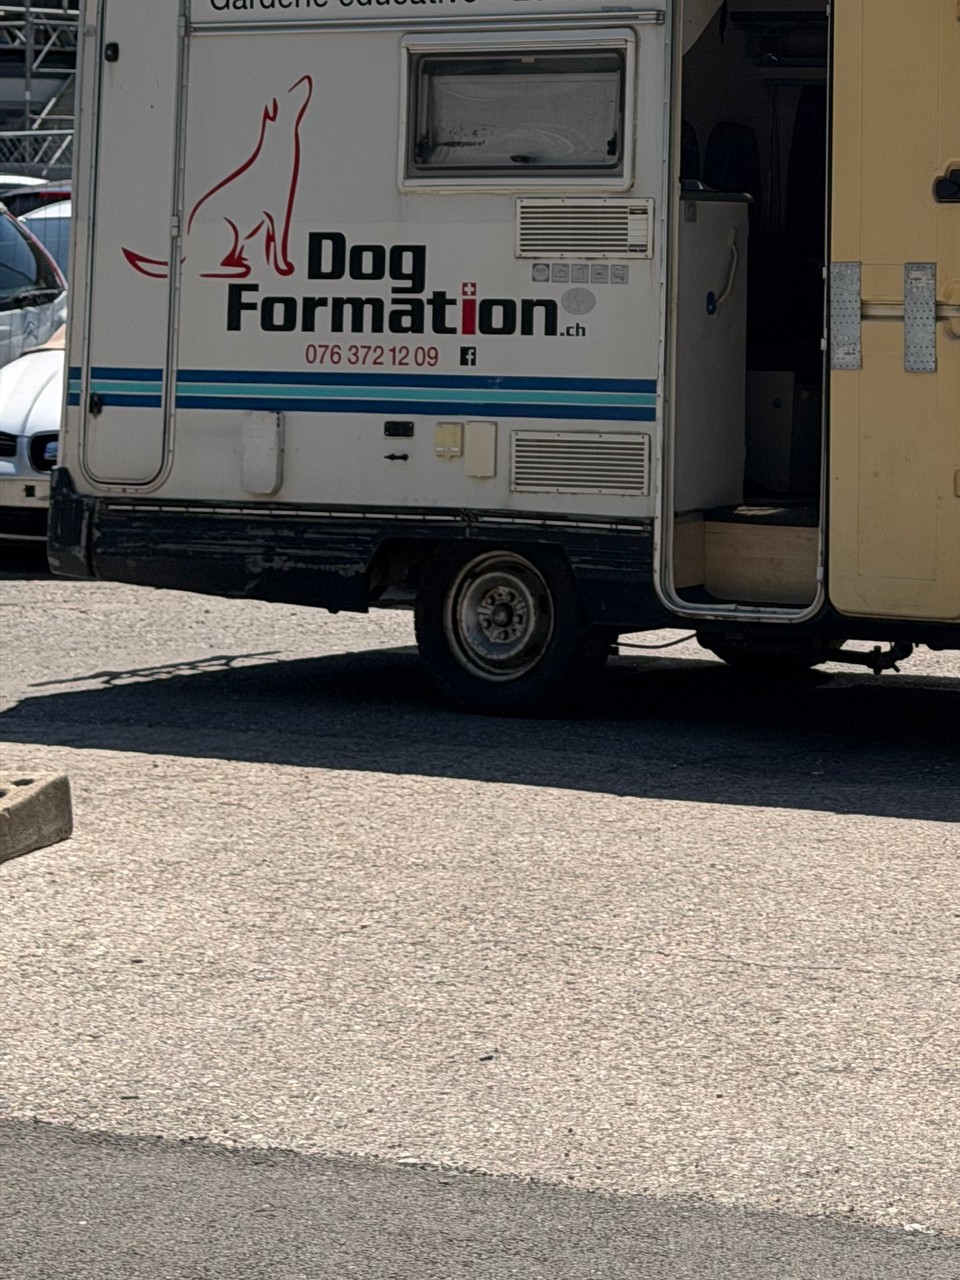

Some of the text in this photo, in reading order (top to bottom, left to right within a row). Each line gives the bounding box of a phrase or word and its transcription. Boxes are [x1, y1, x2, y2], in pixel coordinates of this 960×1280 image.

[308, 232, 426, 294] Dog
[305, 344, 439, 367] 076 372 12 09
